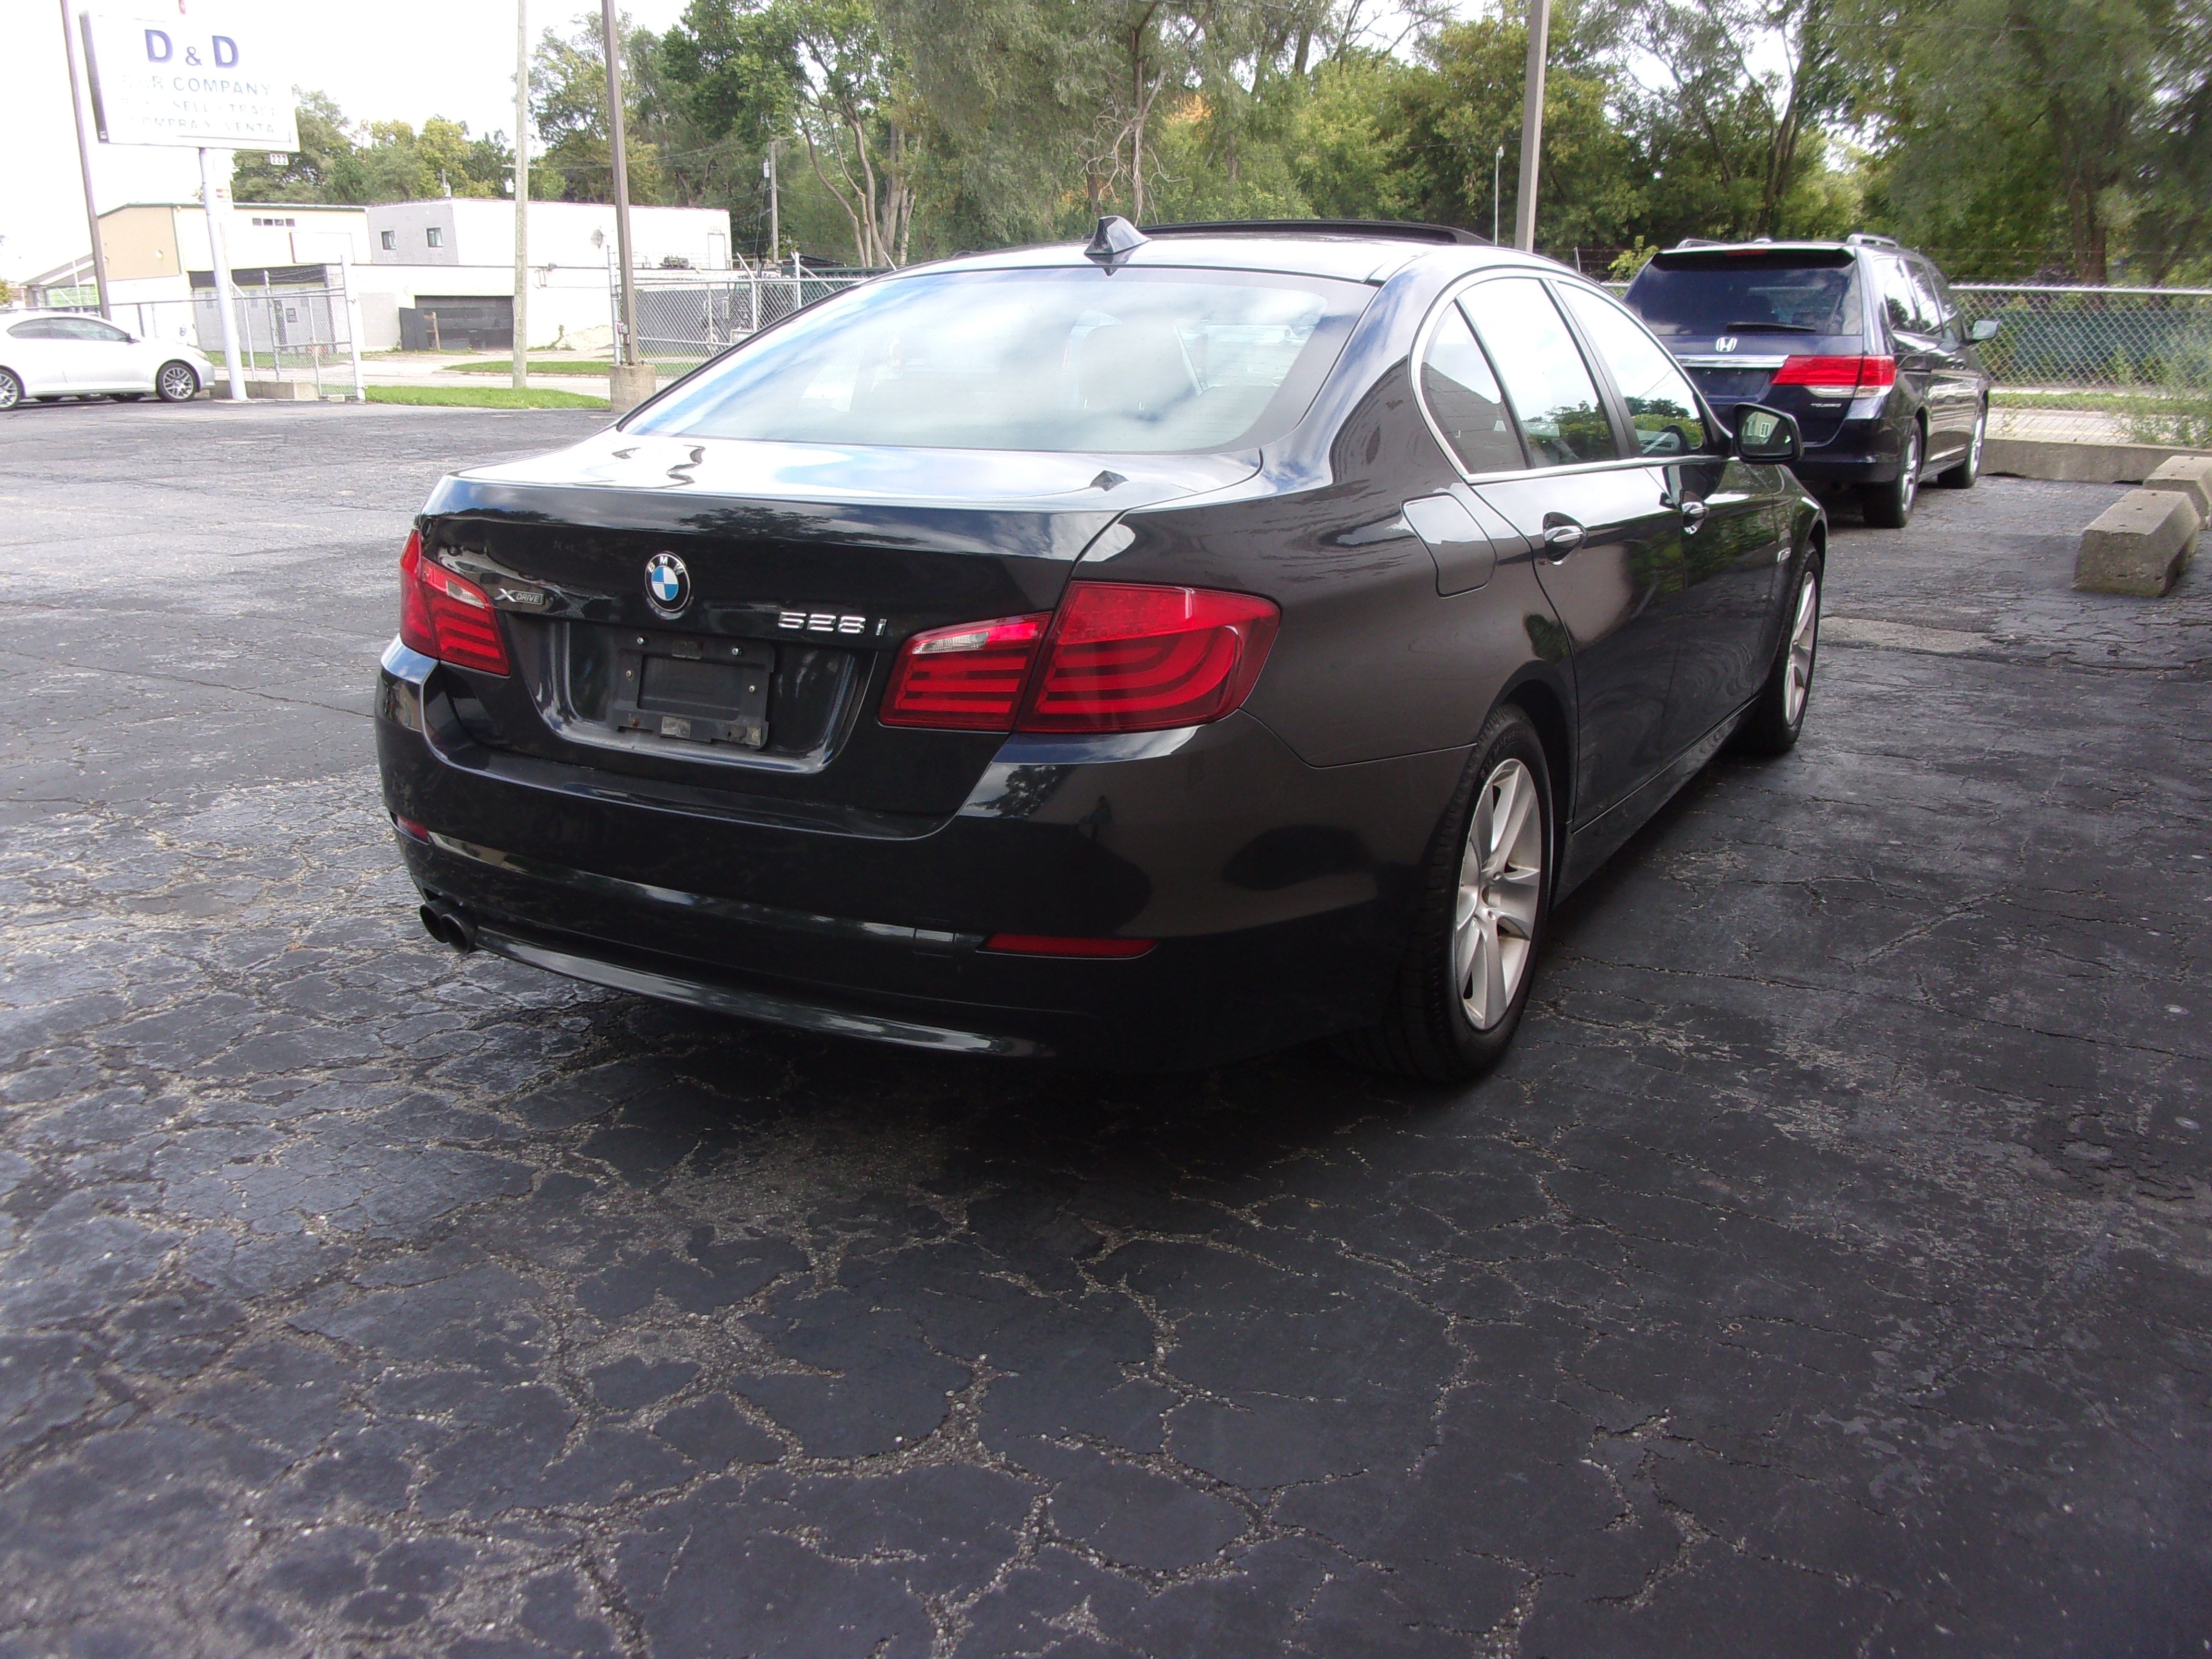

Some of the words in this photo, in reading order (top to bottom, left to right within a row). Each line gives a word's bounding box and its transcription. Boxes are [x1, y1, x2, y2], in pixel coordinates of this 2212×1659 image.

[145, 29, 173, 62] D
[185, 46, 202, 66] &
[212, 35, 239, 68] D
[122, 73, 164, 90] CR
[173, 76, 270, 96] COMPANY
[648, 556, 684, 574] BMW
